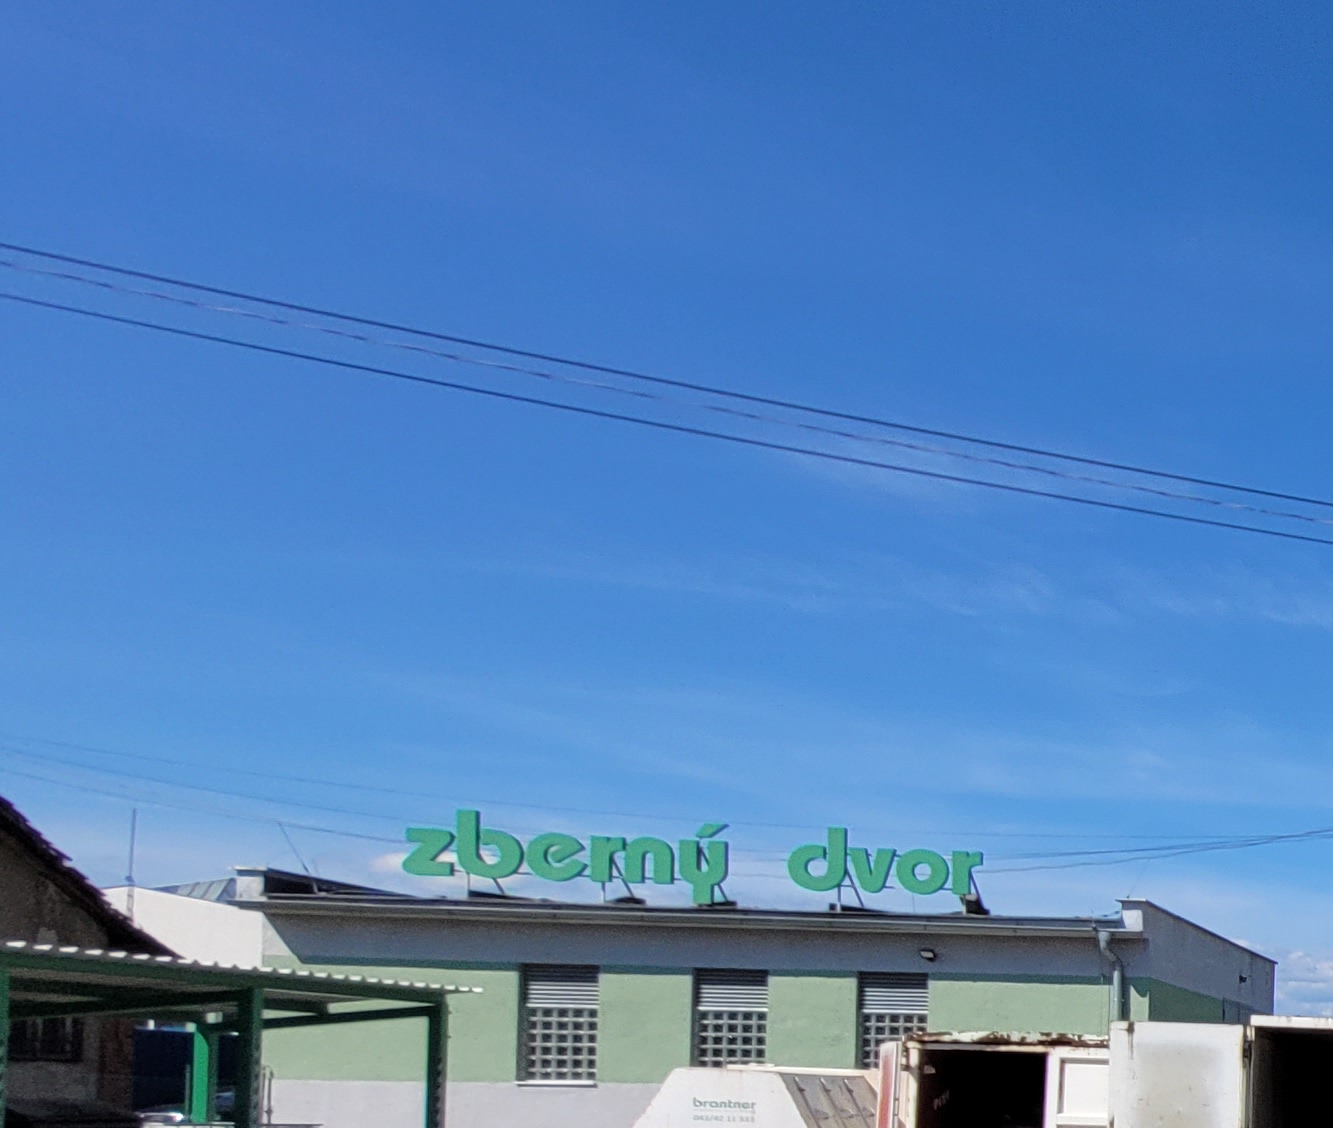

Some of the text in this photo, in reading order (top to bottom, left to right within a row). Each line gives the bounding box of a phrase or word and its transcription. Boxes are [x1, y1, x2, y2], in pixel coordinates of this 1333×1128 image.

[402, 809, 983, 906] zberný dvor
[692, 1097, 757, 1109] brantner
